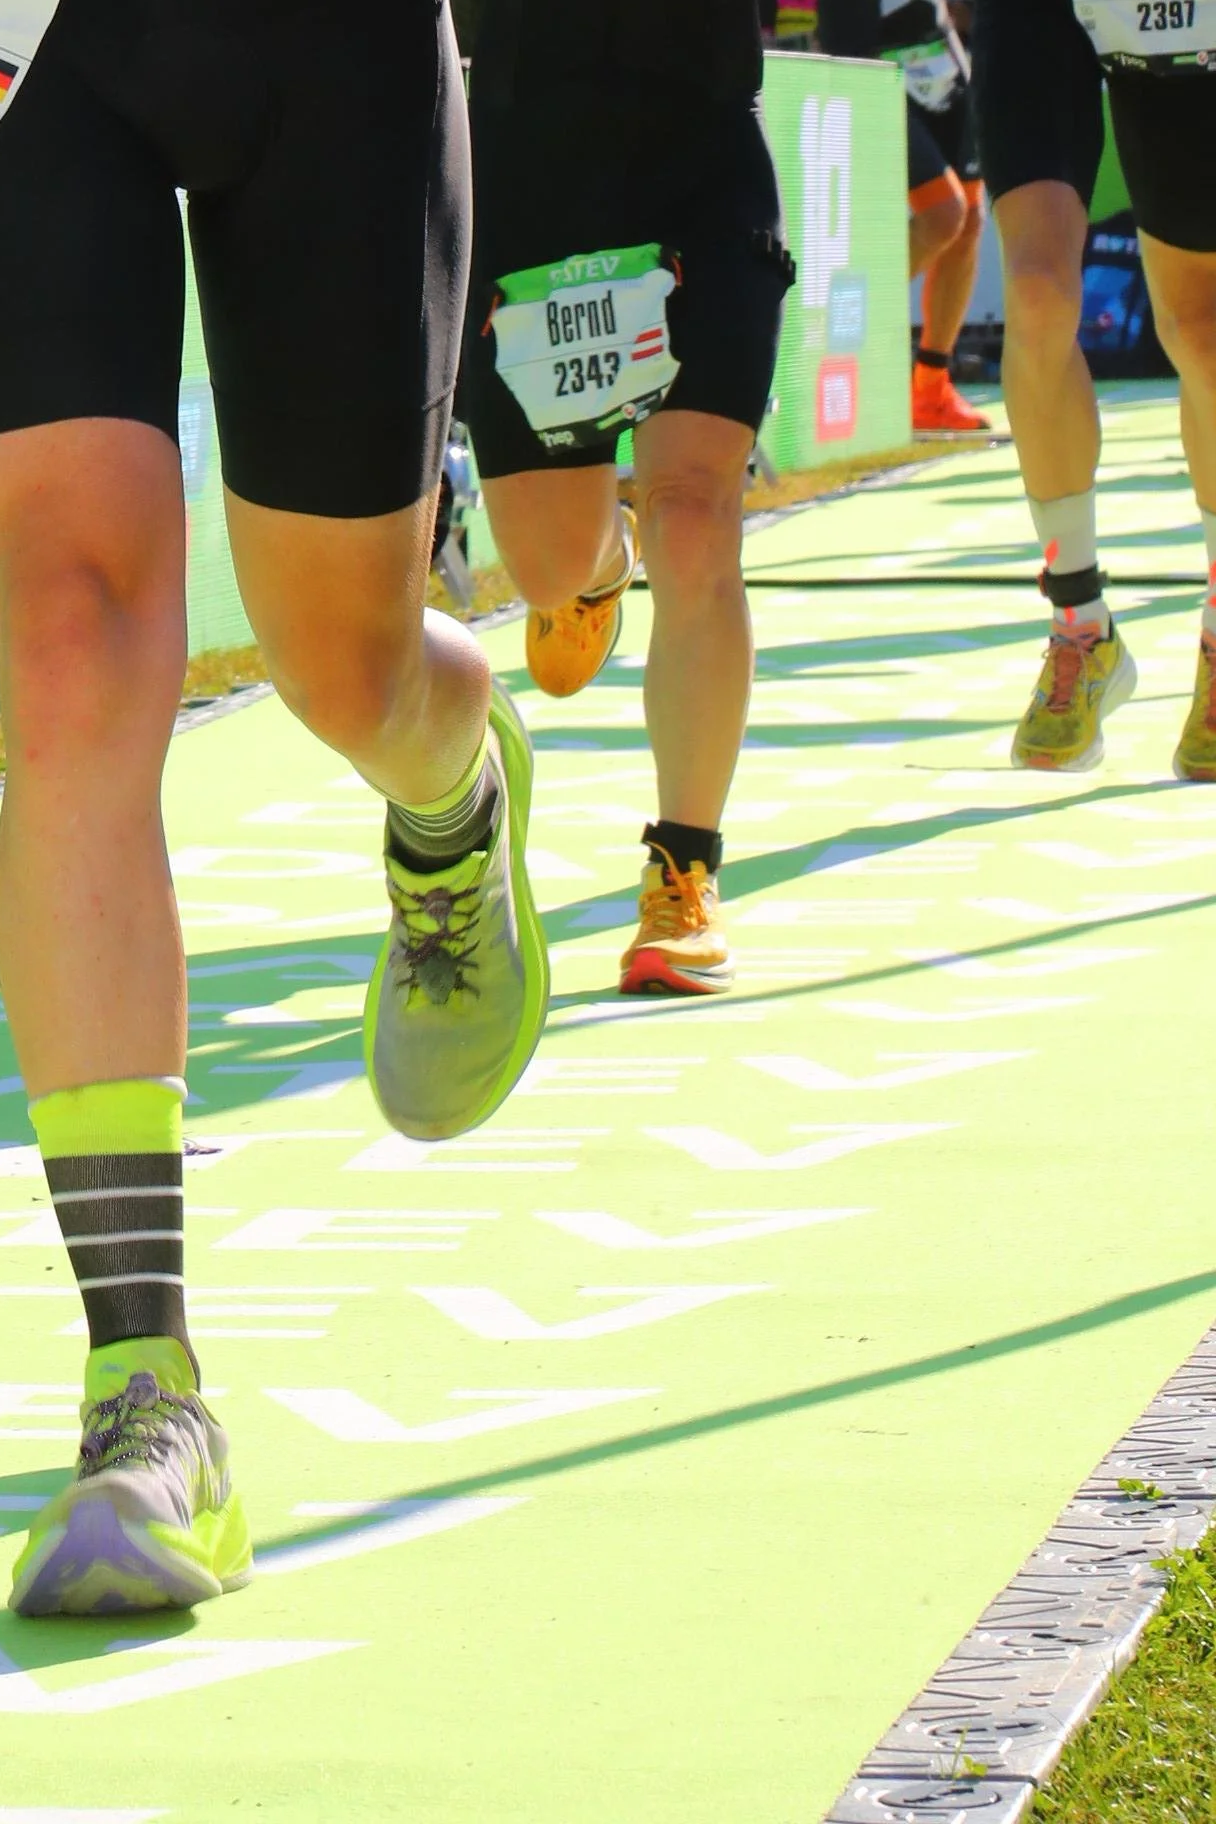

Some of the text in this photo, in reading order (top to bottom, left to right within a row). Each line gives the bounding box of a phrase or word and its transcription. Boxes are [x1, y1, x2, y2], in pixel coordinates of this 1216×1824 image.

[1137, 0, 1195, 31] 2397
[546, 289, 616, 347] Bernd
[554, 351, 620, 397] 2343
